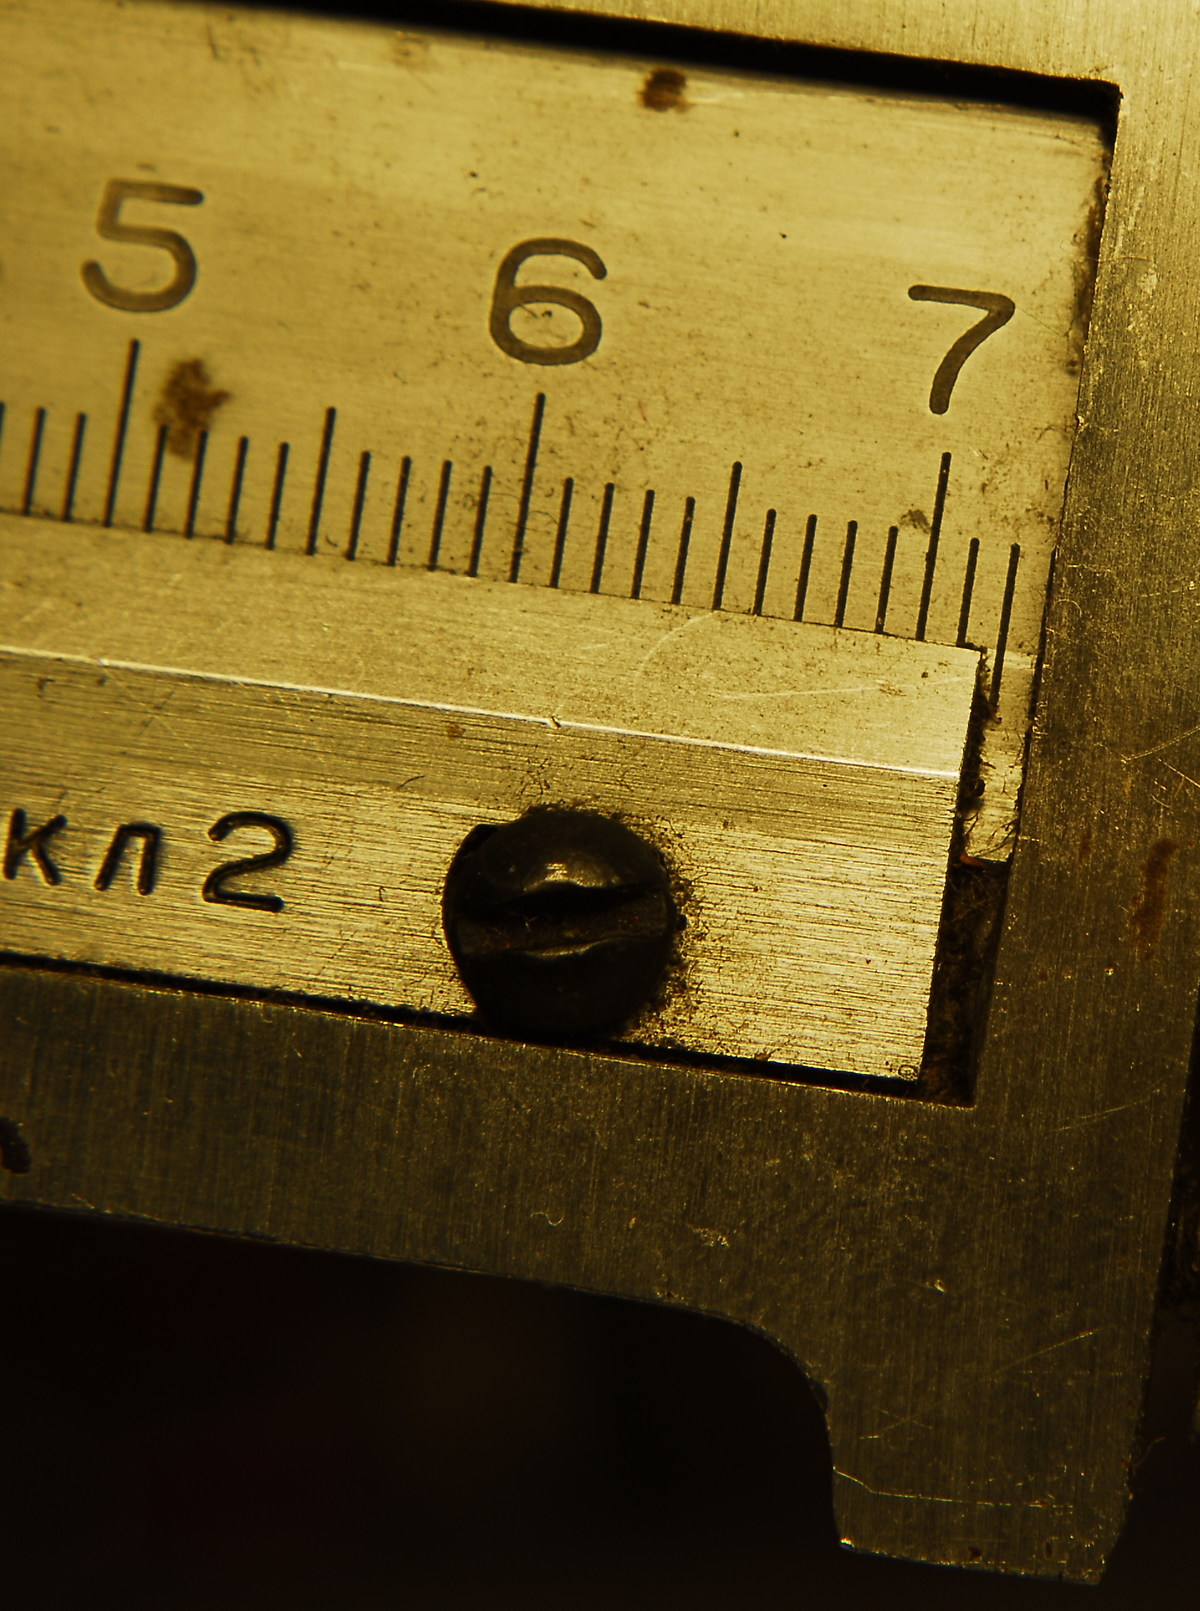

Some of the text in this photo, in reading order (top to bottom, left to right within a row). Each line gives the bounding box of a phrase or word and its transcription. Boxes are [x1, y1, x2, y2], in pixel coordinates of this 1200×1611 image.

[81, 178, 204, 313] 5
[489, 237, 607, 366] 6
[907, 284, 1016, 415] 7
[202, 811, 295, 913] 2
